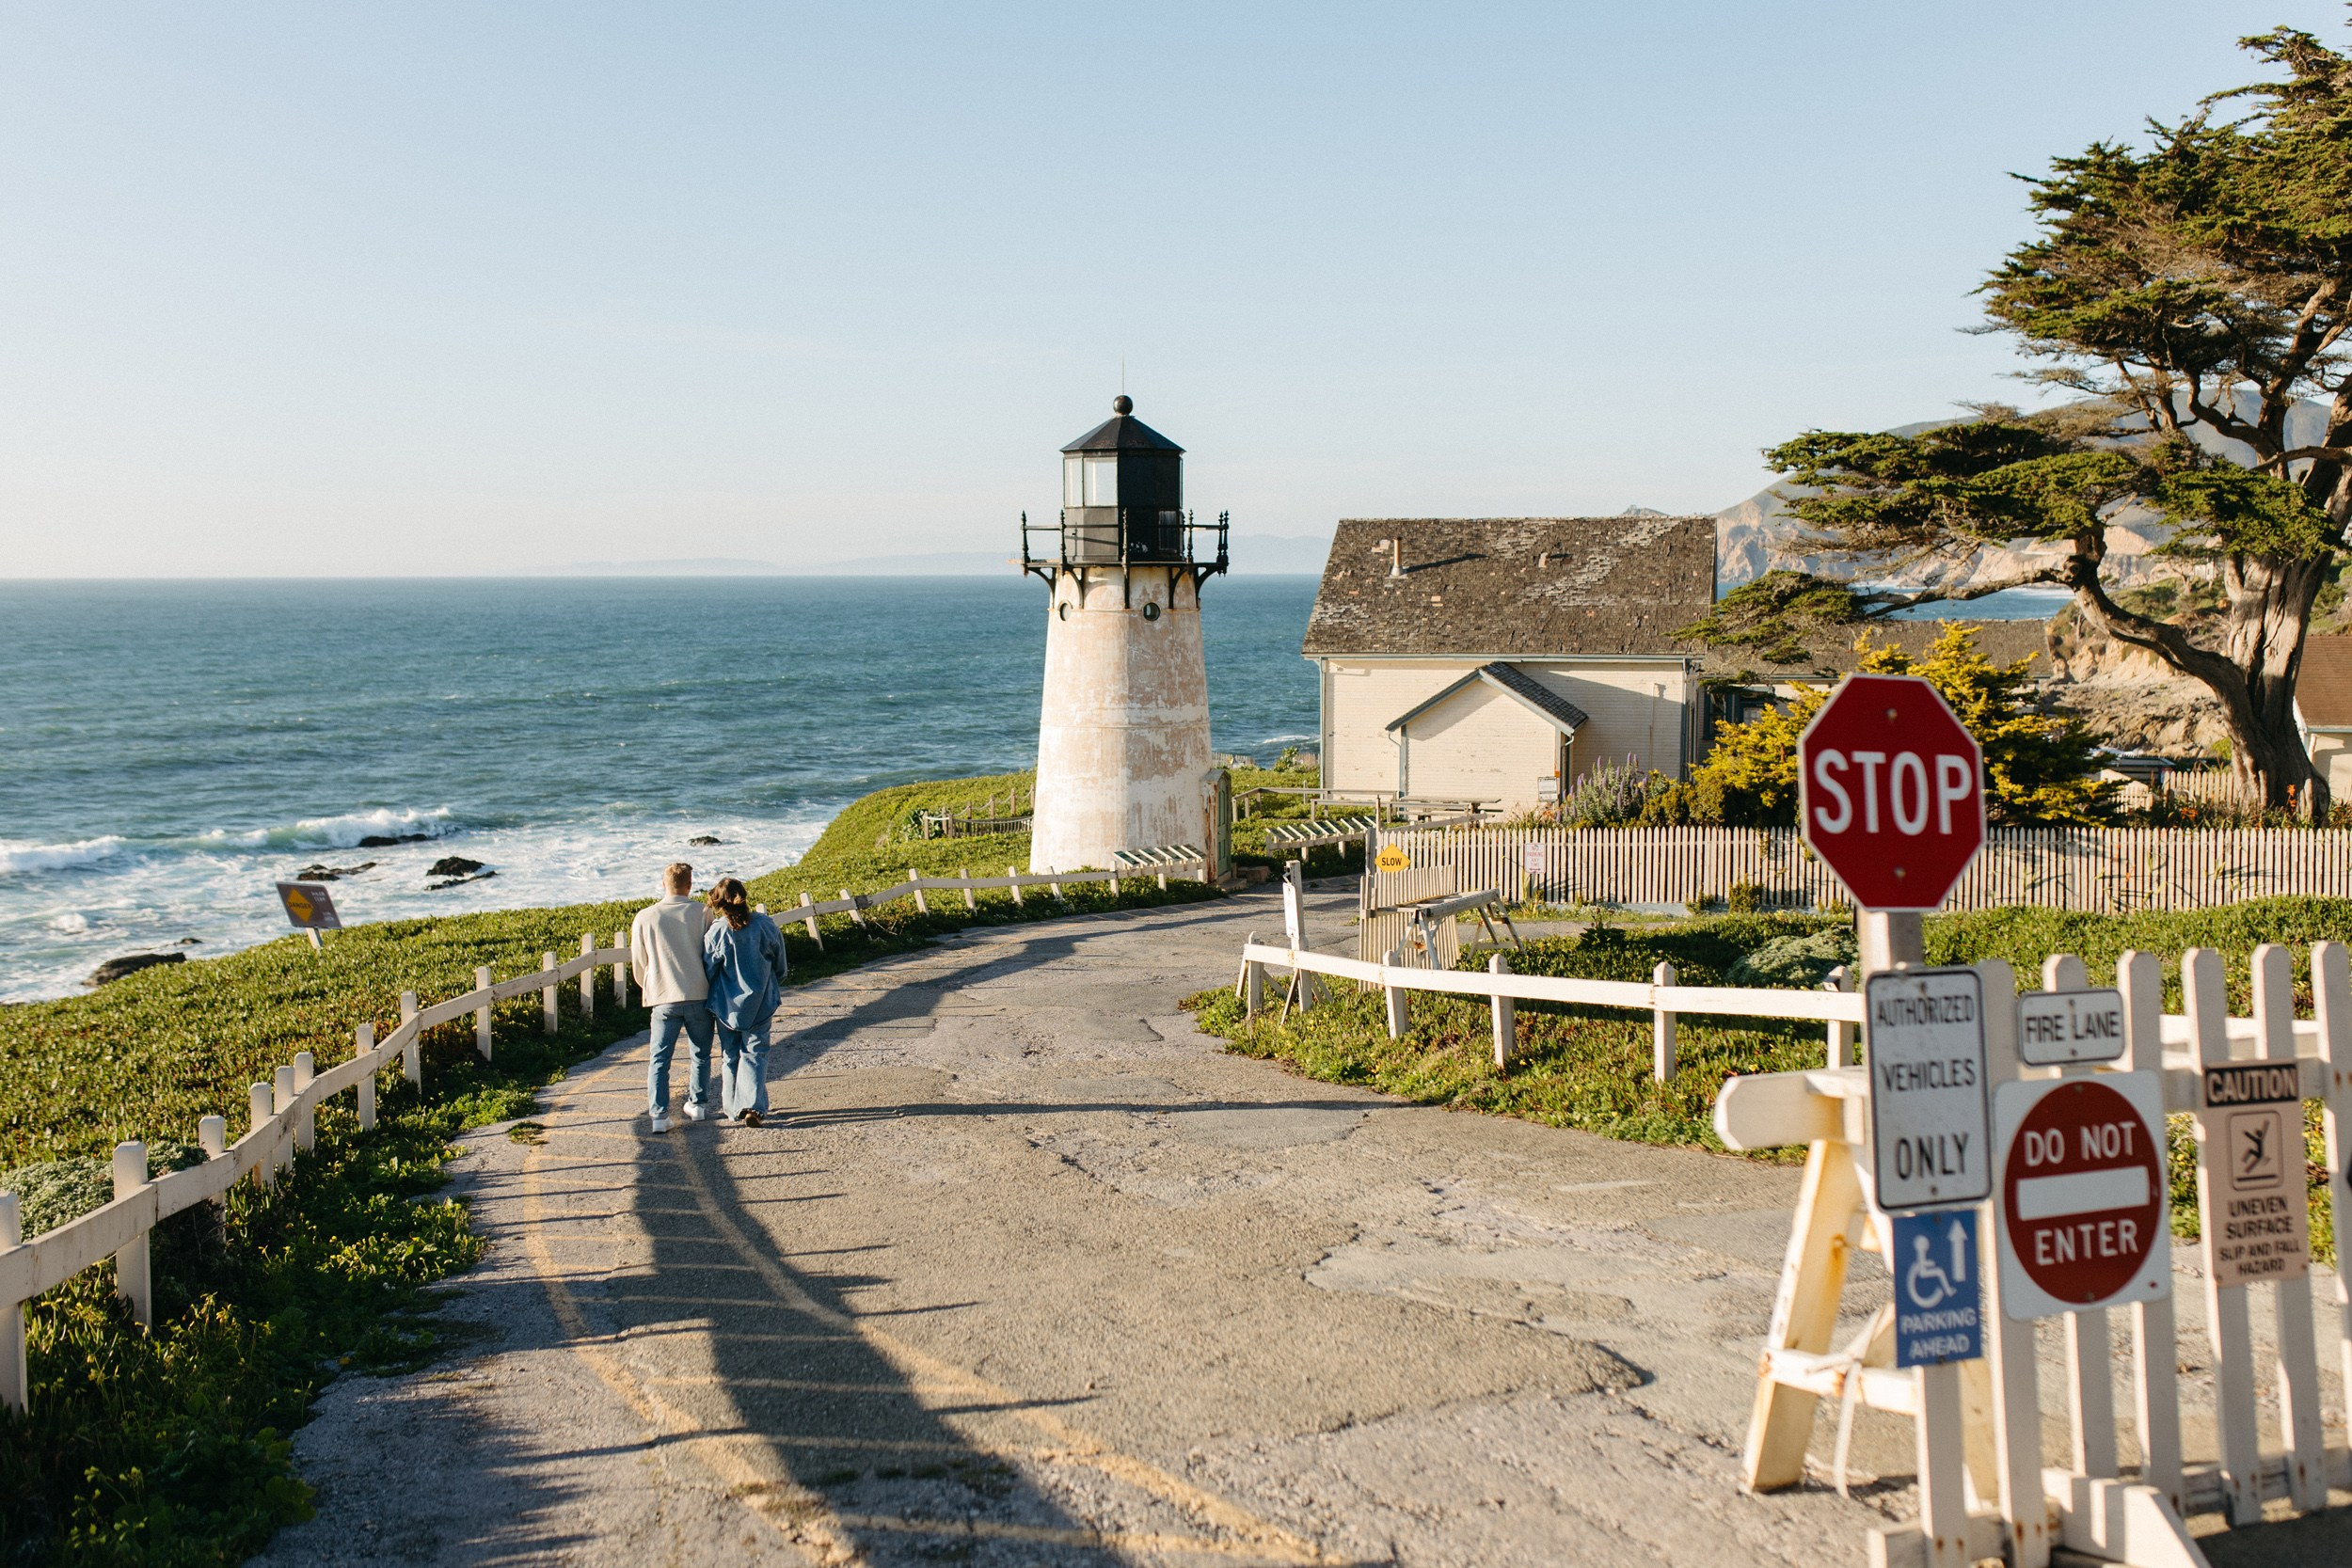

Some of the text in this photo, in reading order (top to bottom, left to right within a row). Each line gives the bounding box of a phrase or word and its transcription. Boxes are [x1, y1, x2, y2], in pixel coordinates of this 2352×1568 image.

[1814, 749, 1973, 835] STOP
[1381, 857, 1403, 866] SLOW
[1877, 995, 1975, 1026] AUTHORIZED
[2026, 1011, 2121, 1042] FIRE LANE
[1882, 1058, 1976, 1091] VEHICLES
[2208, 1068, 2297, 1103] CAUTION
[1896, 1132, 1969, 1180] ONLY
[2025, 1121, 2137, 1166] DO NOT
[2229, 1196, 2288, 1217] UNEVEN
[2034, 1219, 2138, 1266] ENTER
[2226, 1216, 2293, 1240] SURFACE
[2219, 1239, 2301, 1261] SLIP AND FALL
[2238, 1258, 2285, 1275] HAZARD
[1900, 1307, 1977, 1335] PARKING
[1909, 1334, 1970, 1359] AHEAD
